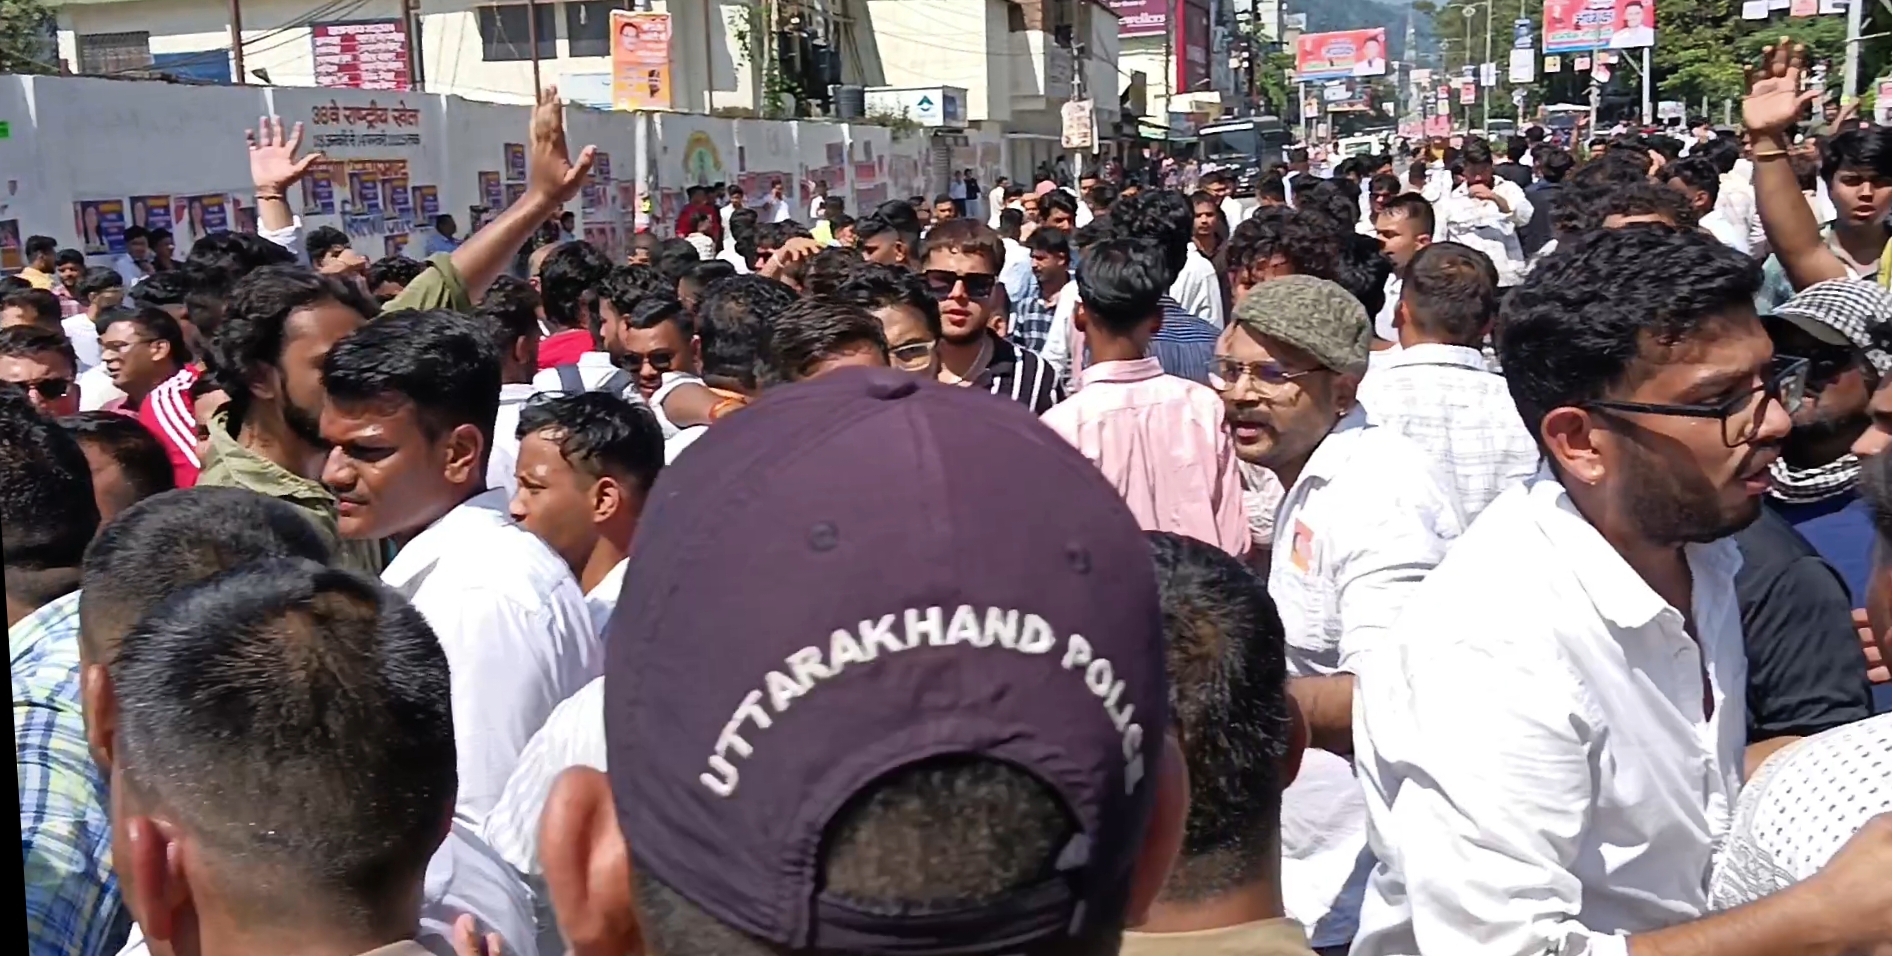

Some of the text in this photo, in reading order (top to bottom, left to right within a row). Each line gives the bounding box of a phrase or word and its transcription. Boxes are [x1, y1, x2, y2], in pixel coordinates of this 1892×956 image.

[343, 99, 389, 129] राष्ट्रीय
[391, 99, 420, 127] खेल
[699, 604, 1056, 797] UTTARAKHAND
